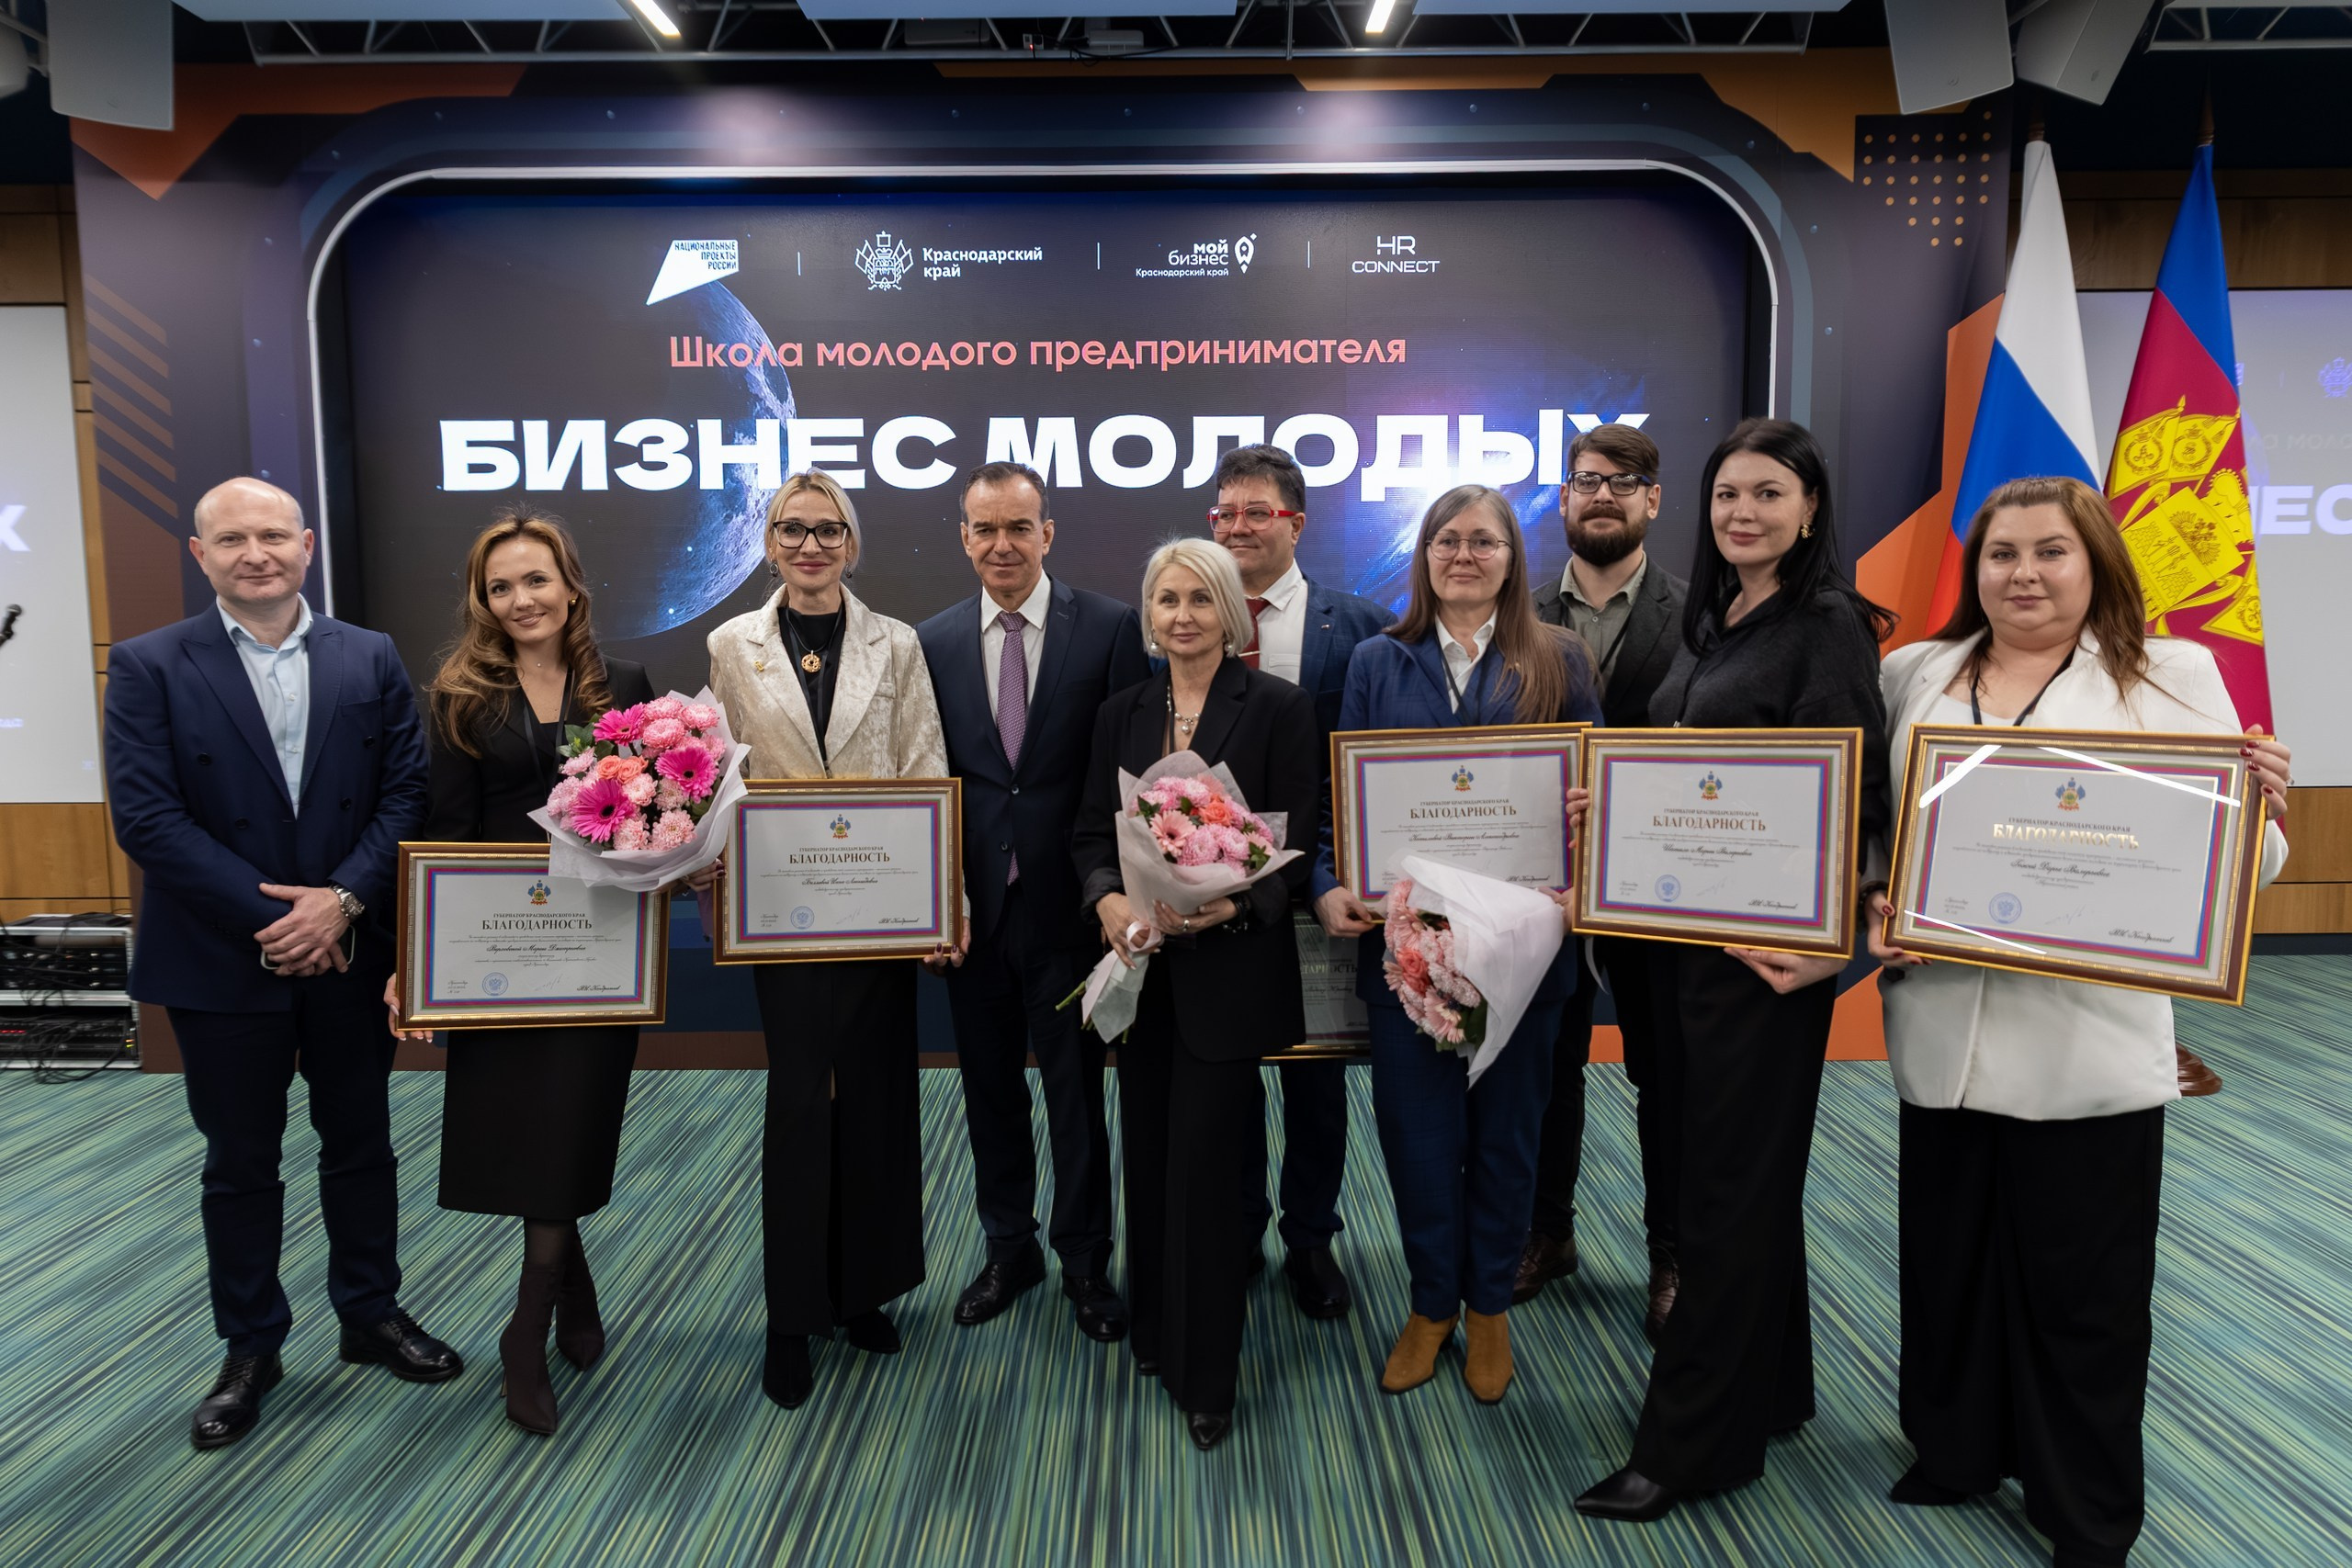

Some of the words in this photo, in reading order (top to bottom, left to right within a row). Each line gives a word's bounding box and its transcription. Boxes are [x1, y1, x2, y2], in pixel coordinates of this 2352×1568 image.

[674, 242, 736, 252] НАЦИОНАЛЬНЫЕ
[1193, 239, 1229, 254] мой
[1376, 235, 1416, 255] HR
[701, 251, 736, 260] ПРОЕКТЫ
[923, 245, 1044, 265] Краснодарский
[1168, 249, 1229, 265] бизнес
[707, 261, 737, 270] РОССИИ
[923, 264, 962, 280] край
[1136, 267, 1204, 278] Краснодарский
[1205, 267, 1229, 278] край
[1351, 260, 1440, 274] CONNECT
[669, 335, 803, 368] Школа
[816, 341, 1017, 372] молодого
[1029, 338, 1407, 372] предпринимателя
[438, 415, 956, 491] БИЗНЕС
[985, 407, 1651, 502] МОЛОДЫ
[1410, 806, 1517, 818] БЛАГОДАРНОСТЬ
[1653, 816, 1766, 831] БЛАГОДАРНОСТЬ
[2008, 817, 2050, 826] ГУБЕРНАТОР
[2049, 820, 2112, 831] КРАСНОДАРСКОГО
[1992, 823, 2140, 851] БЛАГОДАРНОСТЬ
[789, 852, 890, 864] БЛАГОДАРНОСТЬ
[482, 919, 593, 931] БЛАГОДАРНОСТЬ
